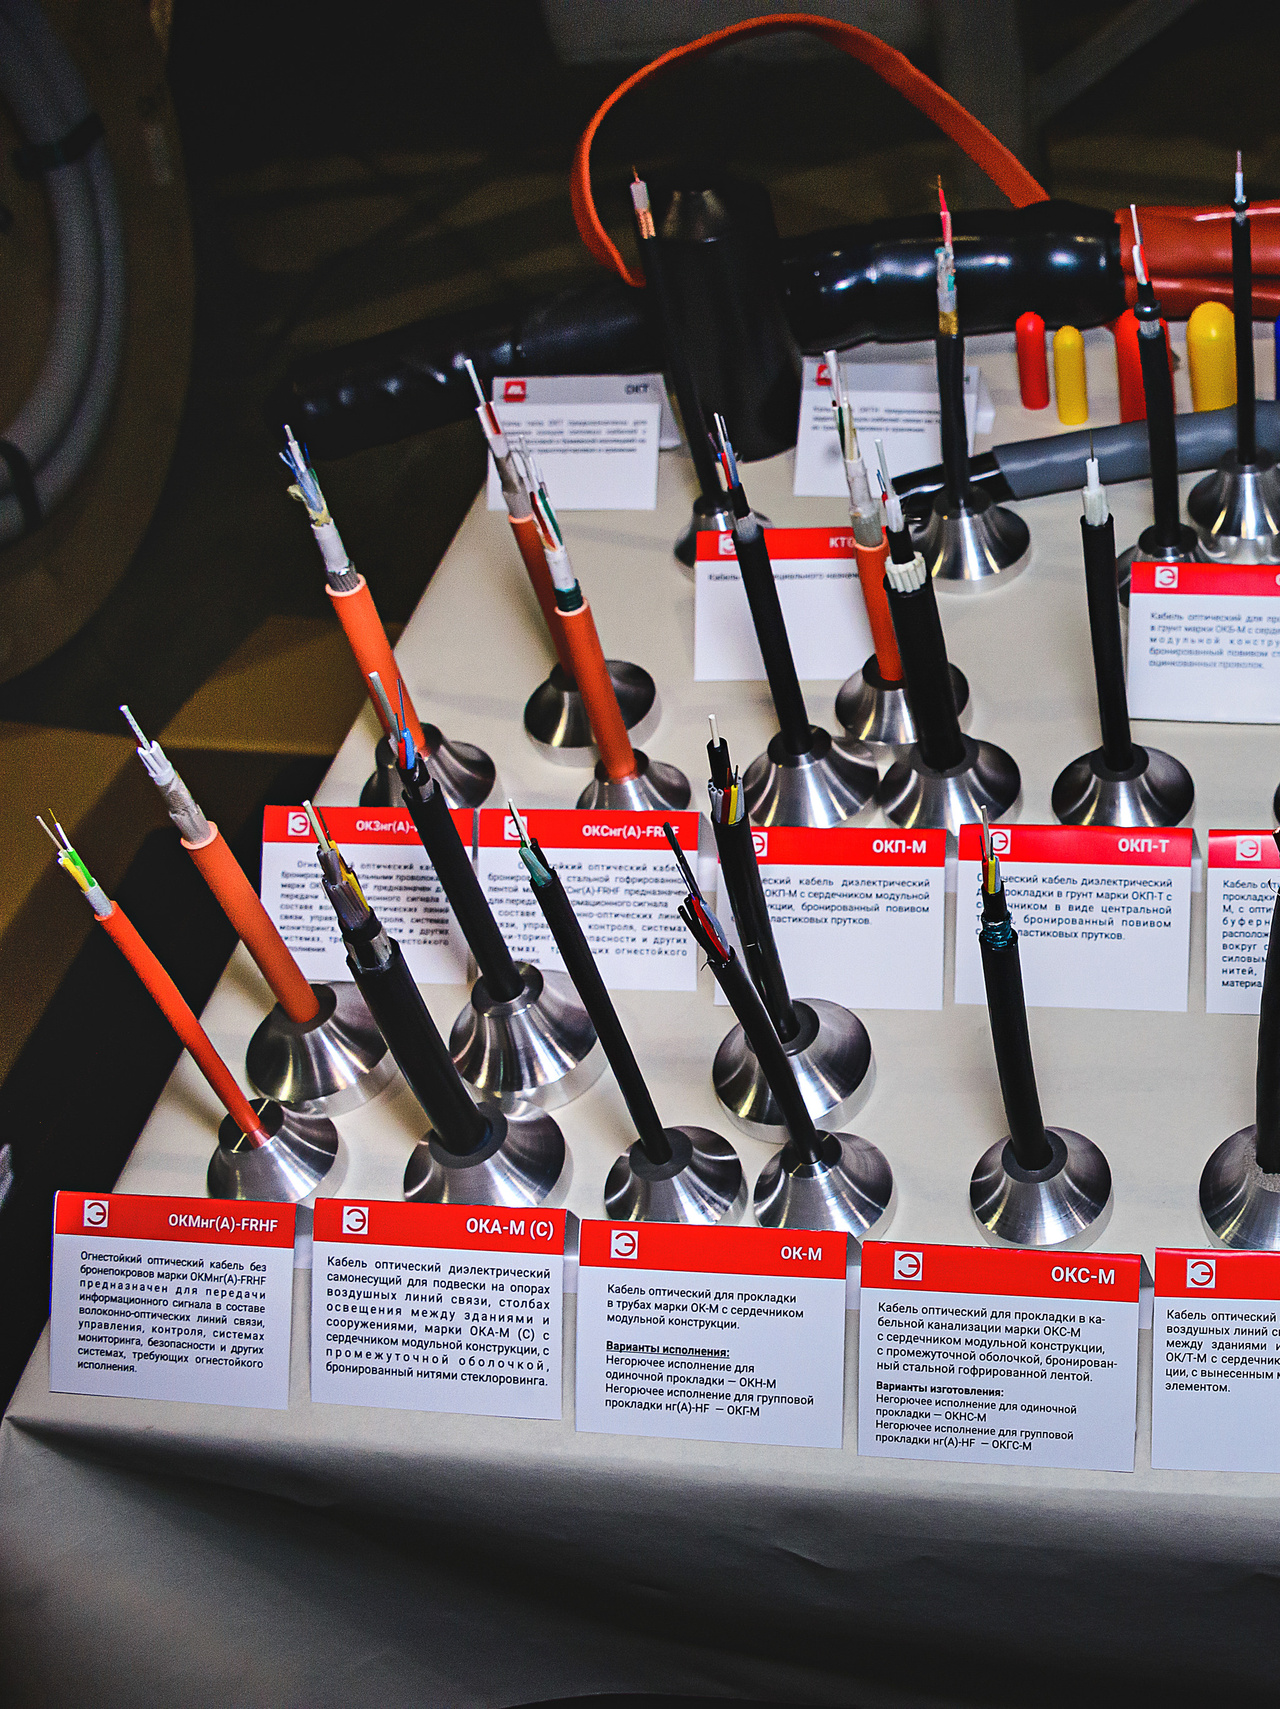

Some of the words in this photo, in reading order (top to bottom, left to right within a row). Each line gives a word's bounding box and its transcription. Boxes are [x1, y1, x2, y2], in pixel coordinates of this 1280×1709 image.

[872, 839, 927, 854] ОКП-М
[1117, 837, 1171, 854] ОКП-Т
[1042, 875, 1078, 885] кабель
[1081, 878, 1172, 888] диэлектрический
[876, 892, 929, 901] модульной
[168, 1213, 279, 1233] ОКМнг(А)-FRHF
[466, 1217, 525, 1236] ОКА-М
[529, 1220, 554, 1241] (С)
[80, 1250, 142, 1264] Огнестойкий
[147, 1257, 204, 1268] оптический
[209, 1260, 245, 1271] кабель
[249, 1261, 267, 1272] без
[780, 1245, 822, 1261] ОК-М
[80, 1264, 155, 1279] бронепокровов
[157, 1271, 188, 1282] марки
[190, 1271, 267, 1286] ОКМнг(А)-FRHF
[327, 1256, 368, 1268] Кабель
[374, 1261, 441, 1273] оптический
[448, 1265, 550, 1279] диэлектрический
[1051, 1266, 1115, 1285] ОКС-М
[327, 1273, 402, 1287] самонесущий
[406, 1278, 428, 1288] для
[433, 1279, 486, 1291] подвески
[491, 1283, 505, 1292] на
[510, 1284, 550, 1296] опорах
[607, 1284, 646, 1295] Кабель
[648, 1288, 711, 1299] оптический
[713, 1291, 734, 1301] для
[737, 1292, 796, 1304] прокладки
[79, 1292, 169, 1307] информационного
[172, 1300, 212, 1310] сигнала
[225, 1303, 266, 1313] составе
[327, 1288, 397, 1301] воздушных
[404, 1293, 443, 1303] линий
[451, 1296, 491, 1308] связи,
[499, 1298, 550, 1310] столбах
[607, 1300, 614, 1308] в
[616, 1299, 652, 1311] трубах
[654, 1302, 688, 1313] марки
[690, 1302, 719, 1314] ОК-М
[721, 1306, 728, 1314] с
[730, 1307, 804, 1318] сердечником
[607, 1314, 665, 1326] модульной
[668, 1318, 740, 1330] конструкции.
[878, 1302, 919, 1314] Кабель
[921, 1307, 987, 1318] оптический
[990, 1310, 1011, 1320] для
[1014, 1311, 1076, 1324] прокладки
[1079, 1315, 1086, 1323] в
[1088, 1316, 1105, 1324] ка-
[1167, 1309, 1207, 1320] Кабель
[1211, 1312, 1276, 1322] оптический
[877, 1316, 924, 1329] бельной
[927, 1321, 1001, 1334] канализации
[1004, 1326, 1040, 1337] марки
[1043, 1326, 1081, 1337] ОКС-М
[1166, 1325, 1230, 1337] воздушных
[1233, 1326, 1268, 1336] линий
[877, 1333, 884, 1341] с
[886, 1333, 961, 1345] сердечником
[964, 1338, 1027, 1350] модульной
[1030, 1342, 1105, 1355] конструкции,
[606, 1354, 665, 1368] Негорючее
[667, 1360, 732, 1372] исполнение
[734, 1364, 755, 1374] для
[1165, 1382, 1230, 1392] элементом.
